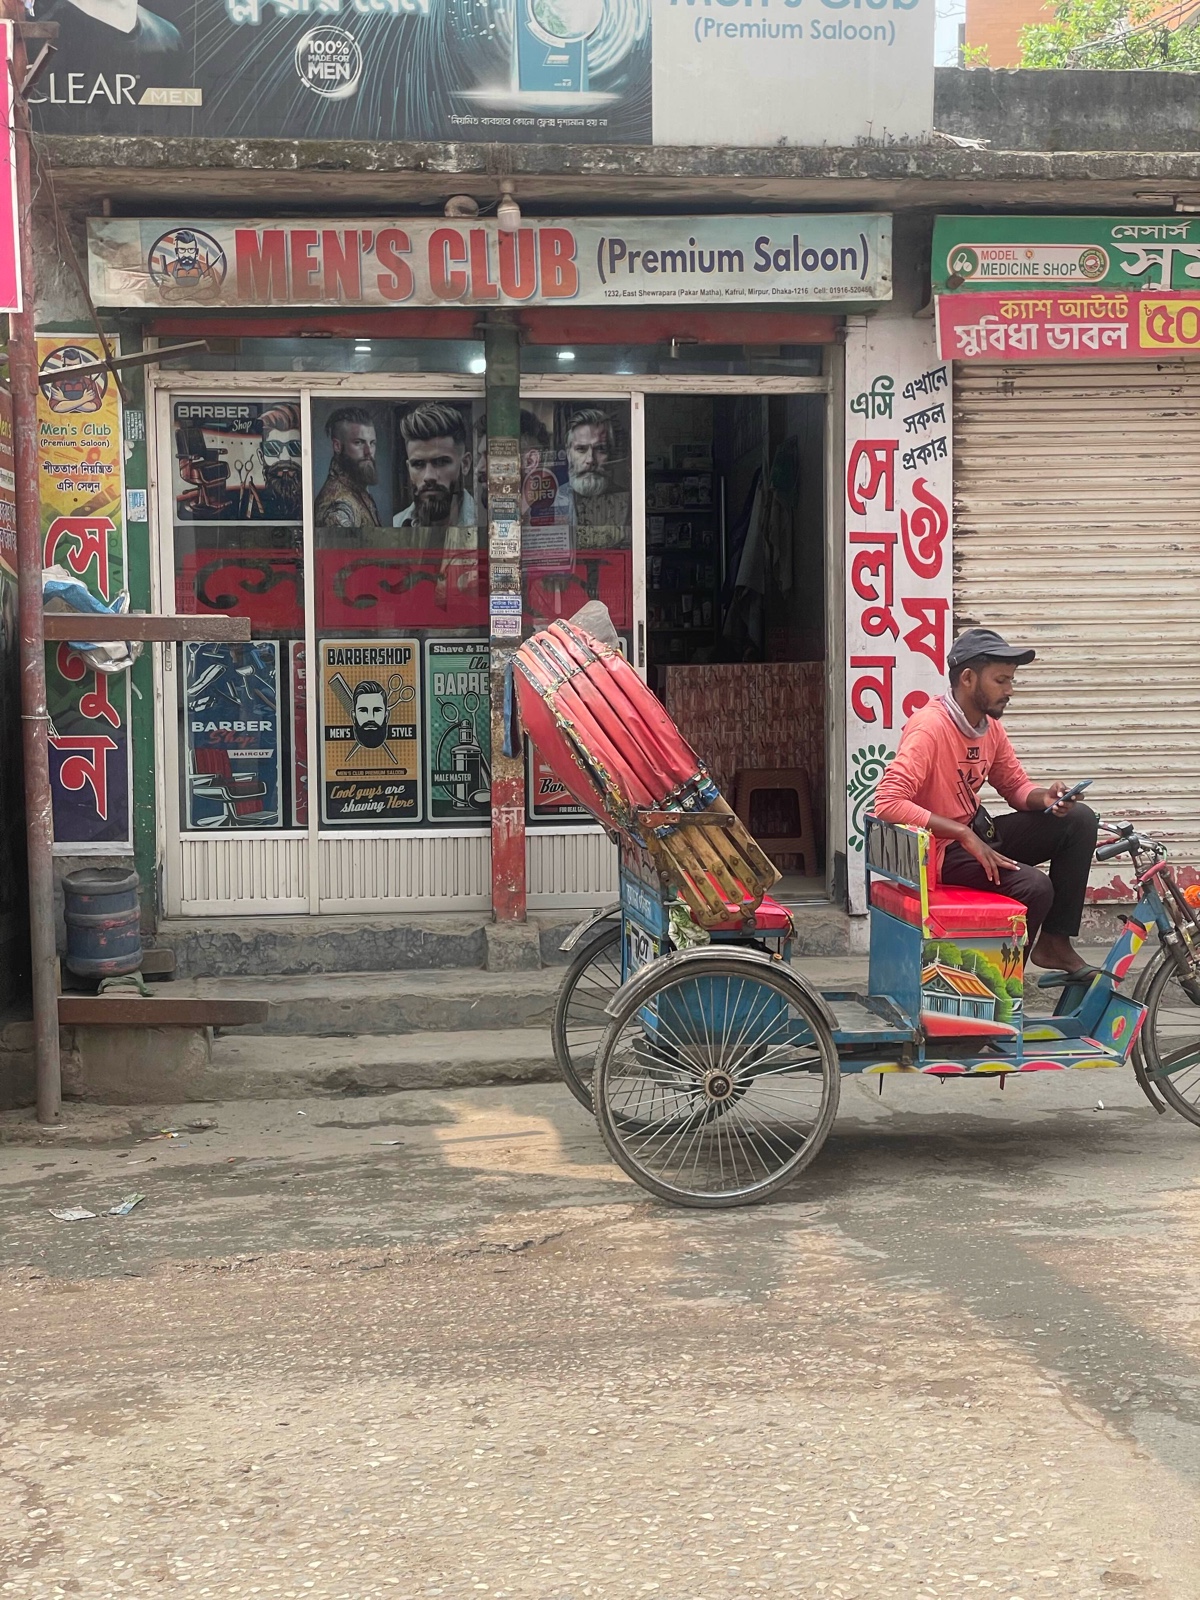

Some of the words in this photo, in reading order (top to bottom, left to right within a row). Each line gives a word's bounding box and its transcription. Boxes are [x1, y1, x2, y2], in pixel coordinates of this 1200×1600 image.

[694, 17, 802, 42] (Premium
[810, 19, 896, 46] Saloon)
[308, 40, 349, 54] 100%
[308, 54, 332, 62] MADE
[333, 54, 349, 62] FOR
[308, 62, 350, 80] MEN
[151, 90, 199, 103] MEN
[1111, 221, 1192, 239] মেসার্স
[980, 250, 1018, 261] MODEL
[234, 228, 412, 300] MEN'S
[428, 227, 579, 300] CLUB
[597, 236, 744, 284] (Premium
[753, 233, 869, 281] Saloon)
[980, 262, 1040, 276] MEDICINE
[1042, 263, 1077, 276] SHOP
[604, 290, 621, 299] 1232,
[622, 289, 637, 297] East
[638, 289, 677, 299] Shewrapara
[677, 288, 699, 298] (Pakar
[747, 288, 771, 296] Mirpur,
[771, 287, 809, 295] Dhaka-1216
[999, 299, 1053, 319] ক্যাশ
[1058, 295, 1129, 319] আউটে
[954, 315, 1039, 356] সুবিধা
[1045, 323, 1129, 350] ডাবল
[902, 366, 948, 401] এখানে
[850, 375, 895, 419] এসি
[178, 406, 249, 418] BARBER
[903, 402, 946, 434] সকল
[40, 423, 78, 436] Men's
[83, 423, 112, 436] Club
[231, 420, 252, 432] Shop
[40, 438, 77, 447] (Premium
[80, 439, 110, 448] Saloon)
[902, 436, 948, 470] প্রকার
[42, 461, 78, 474] শীততাপ
[57, 479, 74, 491] এসি
[77, 482, 101, 493] সেলুন
[433, 645, 464, 653] Shave
[465, 645, 474, 653] &
[475, 645, 489, 653] Ha
[326, 648, 411, 666] BARBERSHOP
[468, 656, 489, 670] Cla
[433, 672, 489, 696] BARBE
[191, 720, 273, 732] BARBER
[329, 728, 351, 739] MEN'S
[391, 727, 413, 738] STYLE
[208, 729, 258, 748] Shop
[434, 773, 449, 782] MALE
[449, 773, 472, 782] MASTER
[330, 784, 357, 799] Cool
[356, 785, 383, 800] guys
[385, 784, 406, 795] are
[539, 778, 566, 795] Bar
[340, 799, 386, 813] shaving
[386, 795, 415, 808] Here
